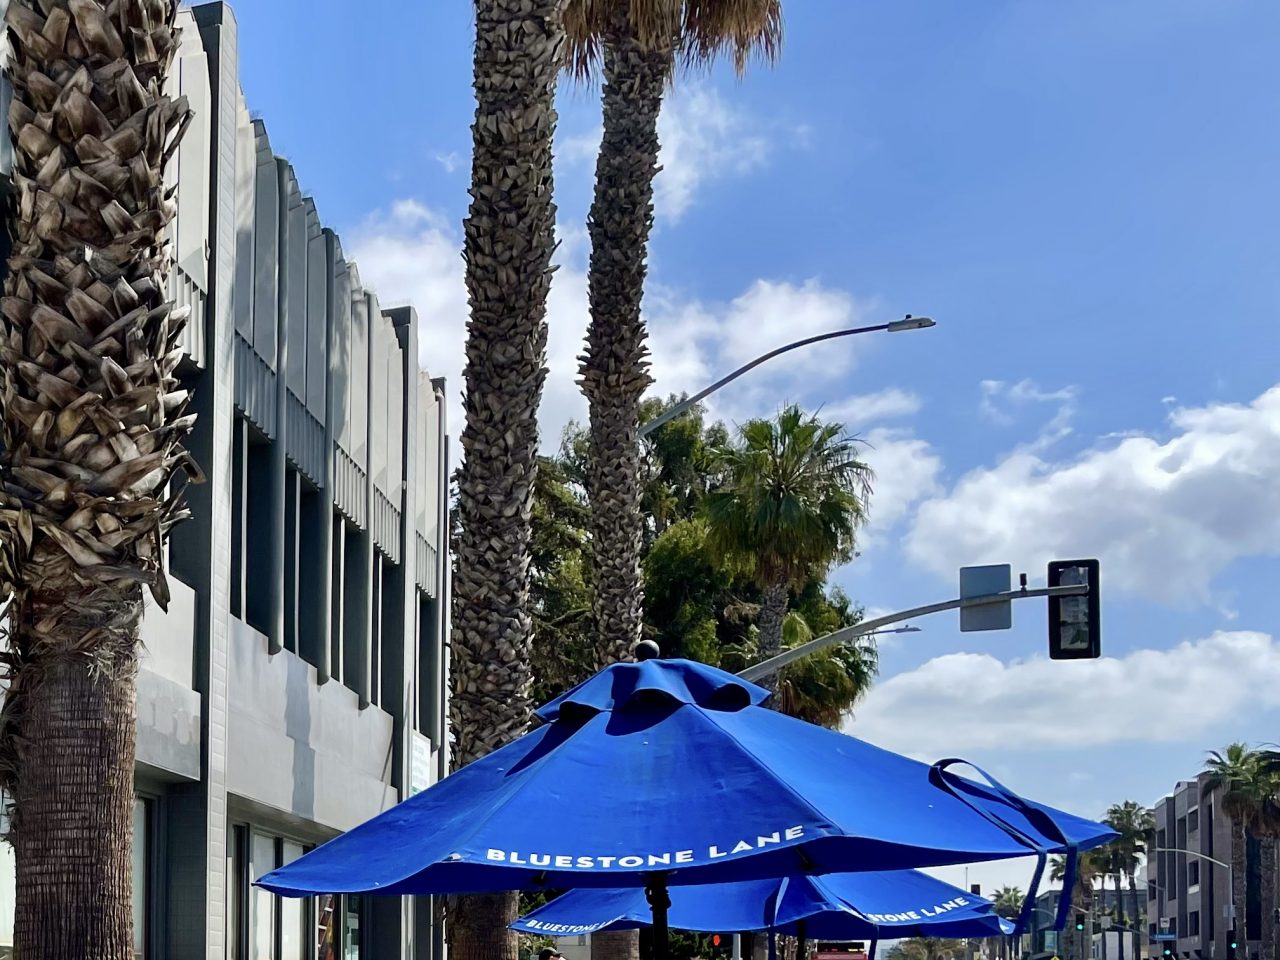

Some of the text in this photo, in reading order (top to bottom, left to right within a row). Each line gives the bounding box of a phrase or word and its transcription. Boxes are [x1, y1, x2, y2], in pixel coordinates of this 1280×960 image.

[486, 824, 805, 869] BLUESTONE LANE
[920, 896, 970, 918] LANE
[525, 918, 600, 934] BLUESTONE
